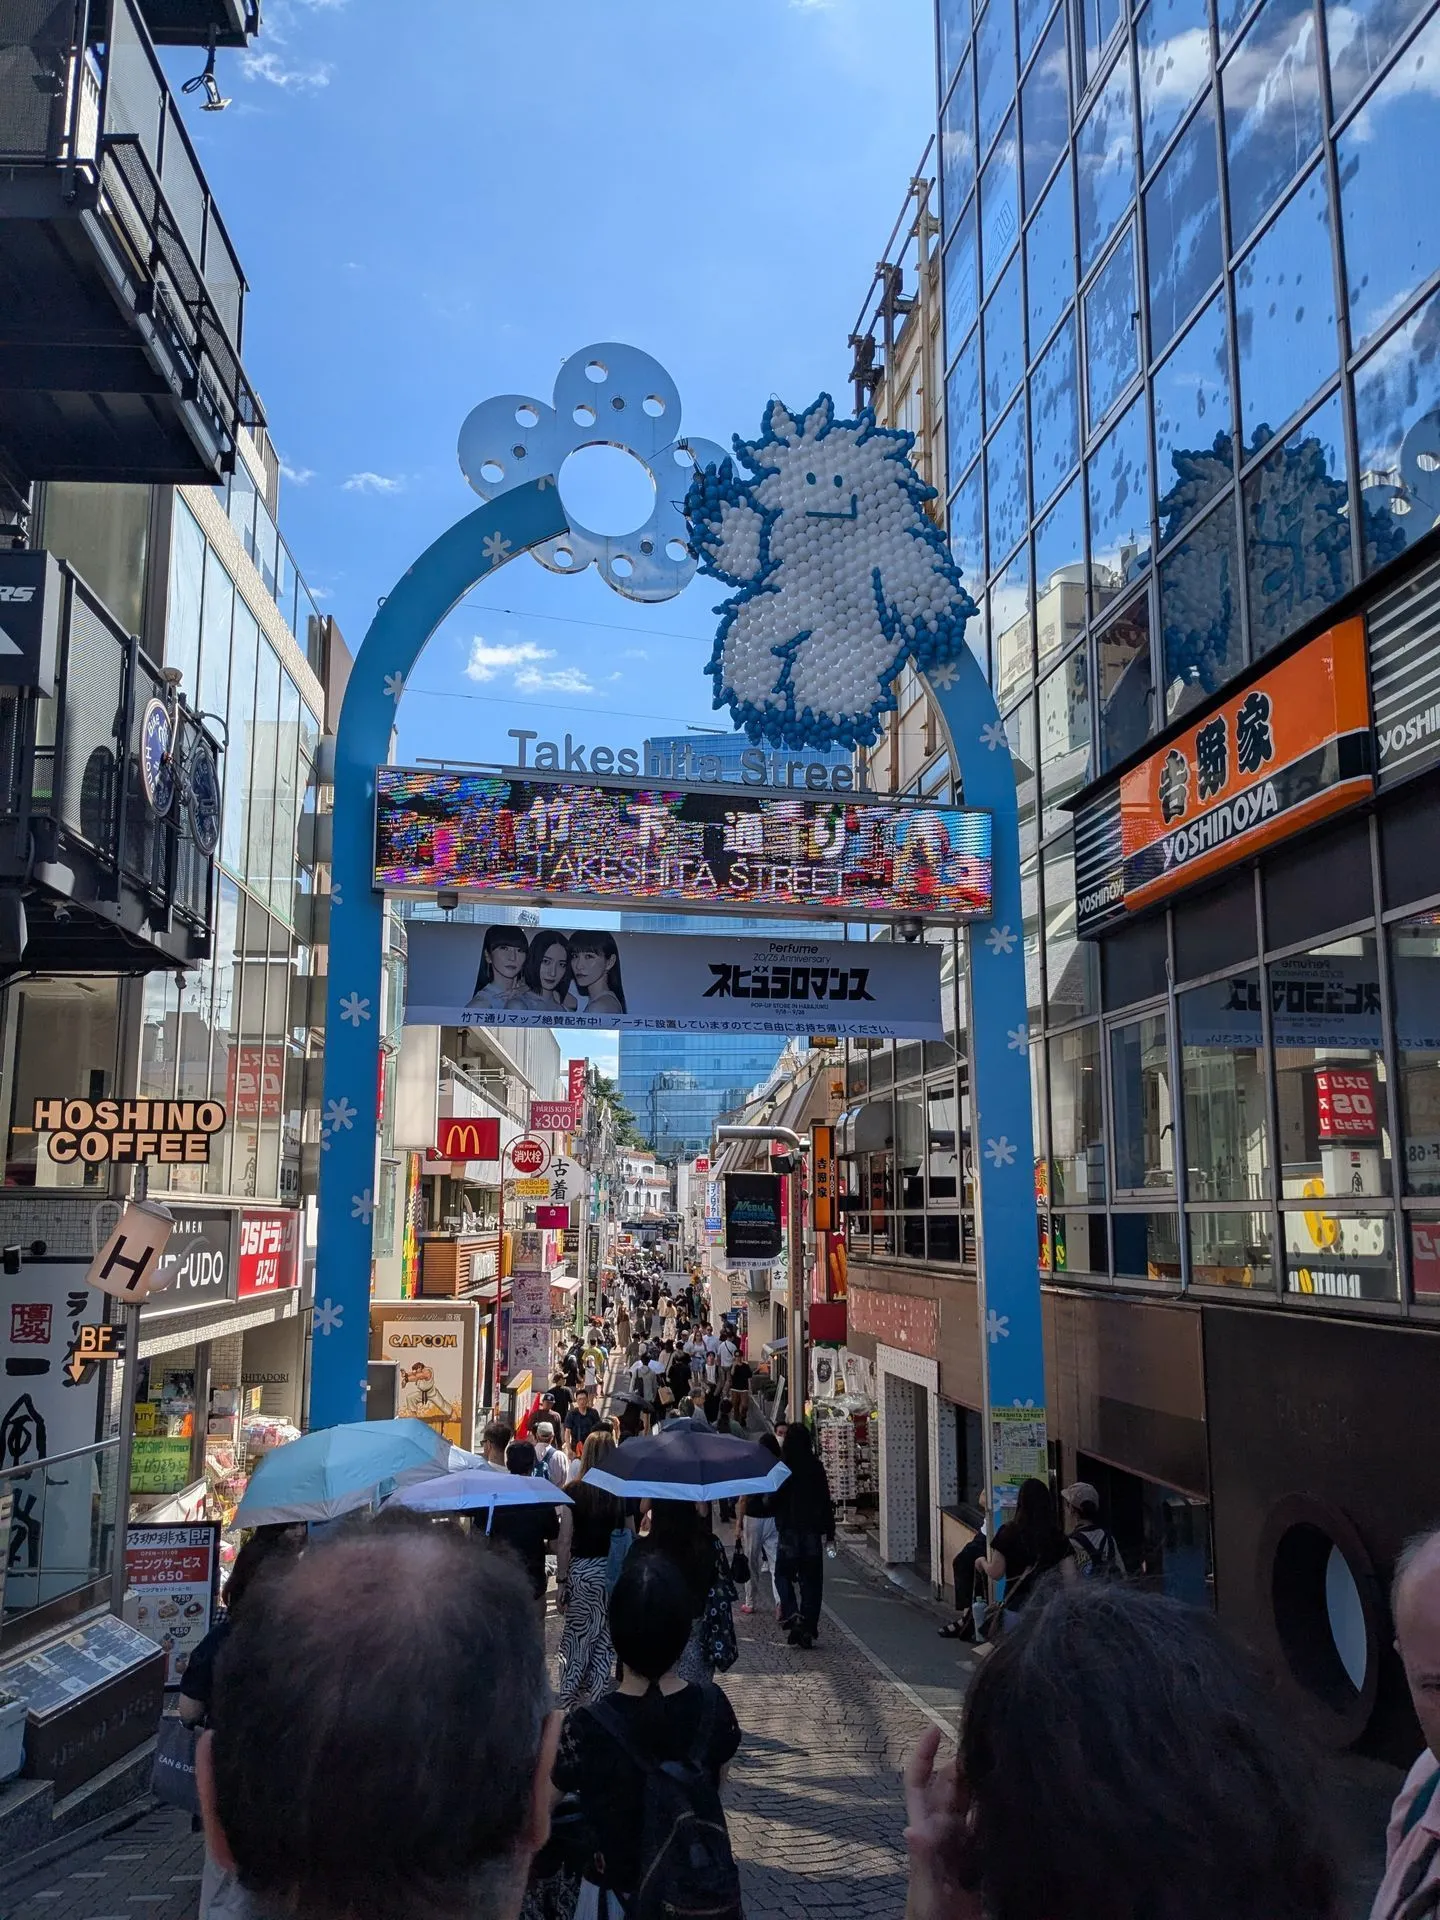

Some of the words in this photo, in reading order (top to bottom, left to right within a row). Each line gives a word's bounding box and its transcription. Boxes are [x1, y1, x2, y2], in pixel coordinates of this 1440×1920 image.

[507, 729, 722, 783] Takeshita
[740, 749, 872, 793] Street
[1158, 691, 1275, 826] 吉野家
[1163, 781, 1278, 871] YOSHINOYA
[535, 851, 718, 890] TAKESHITA
[728, 859, 844, 896] STREET
[769, 943, 819, 954] Perfume
[779, 954, 831, 965] Anniversary
[35, 1100, 224, 1132] HOSHINO
[534, 1113, 571, 1129] ¥300
[50, 1131, 208, 1162] COFFEE
[514, 1150, 542, 1163] 消火栓
[550, 1158, 570, 1200] 古着
[173, 1220, 203, 1234] RAMEN
[99, 1234, 155, 1291] H
[255, 1259, 277, 1287] クスリ
[81, 1327, 113, 1351] BF
[389, 1334, 458, 1348] CAPCOM
[191, 1529, 210, 1540] BF
[175, 1761, 182, 1769] &
